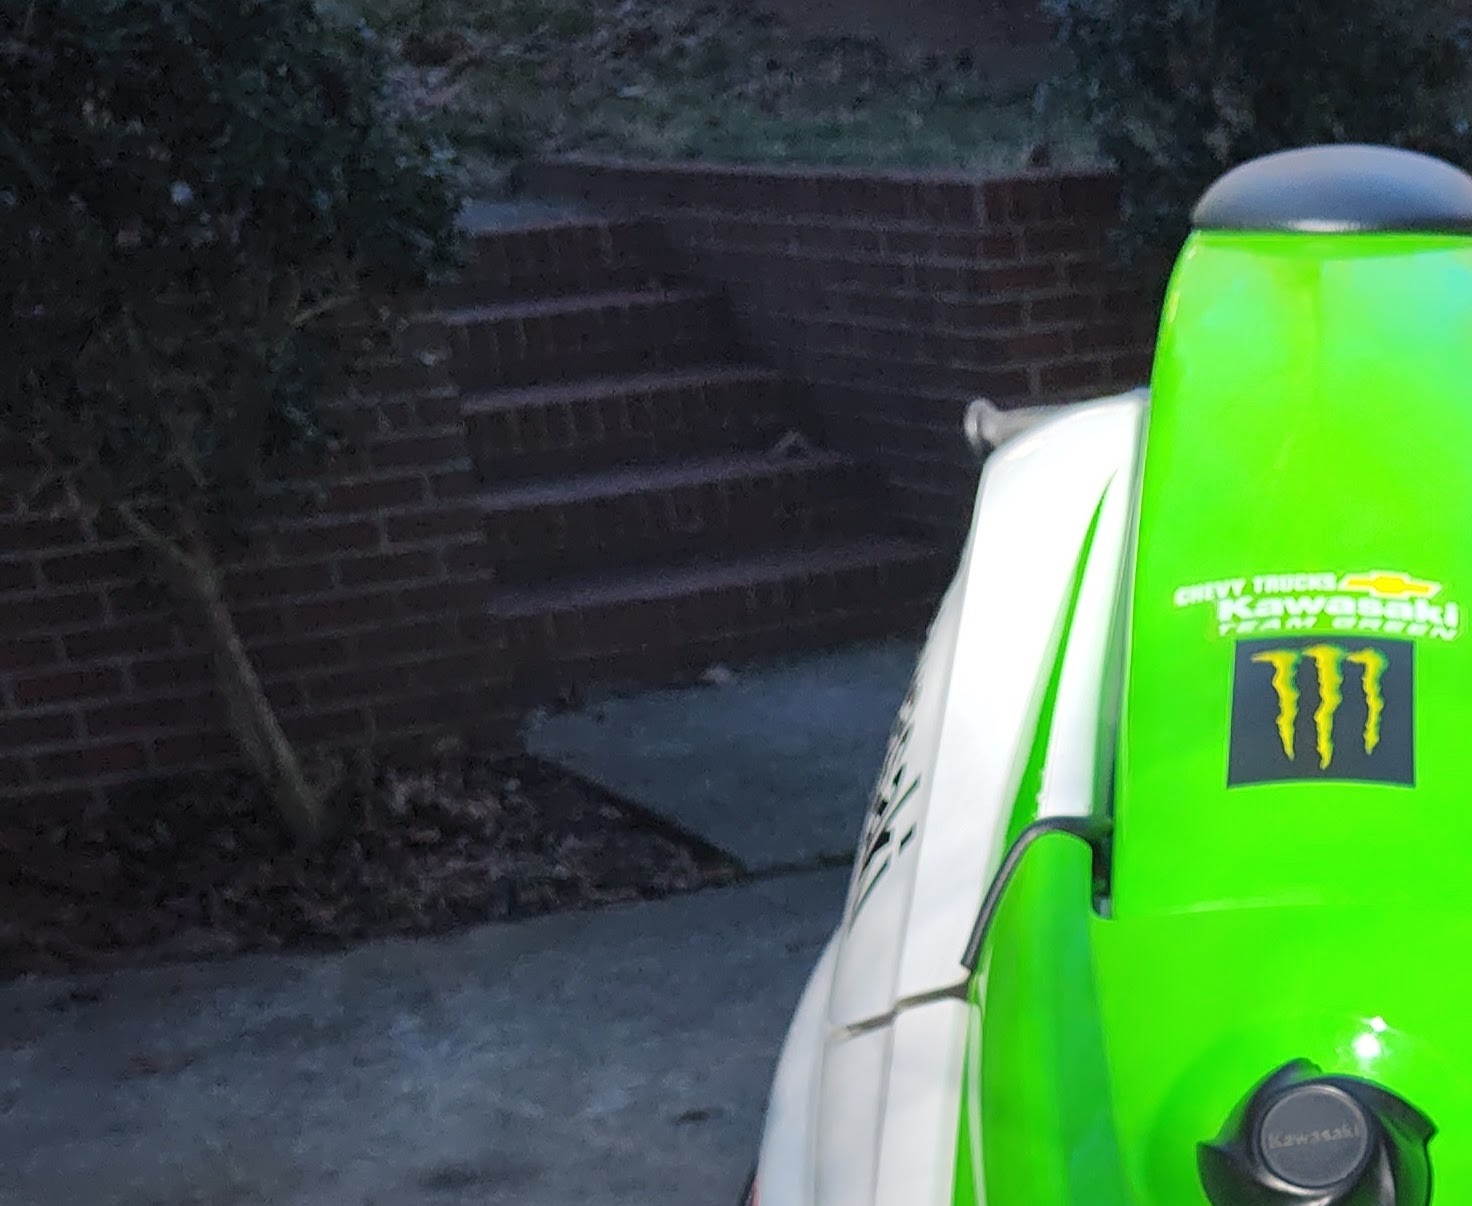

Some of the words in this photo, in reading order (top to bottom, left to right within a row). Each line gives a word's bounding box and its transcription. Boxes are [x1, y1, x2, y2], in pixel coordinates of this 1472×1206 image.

[1175, 577, 1246, 606] CHEVY
[1253, 573, 1335, 594] TRUCKS
[1218, 595, 1458, 628] Kawasaki
